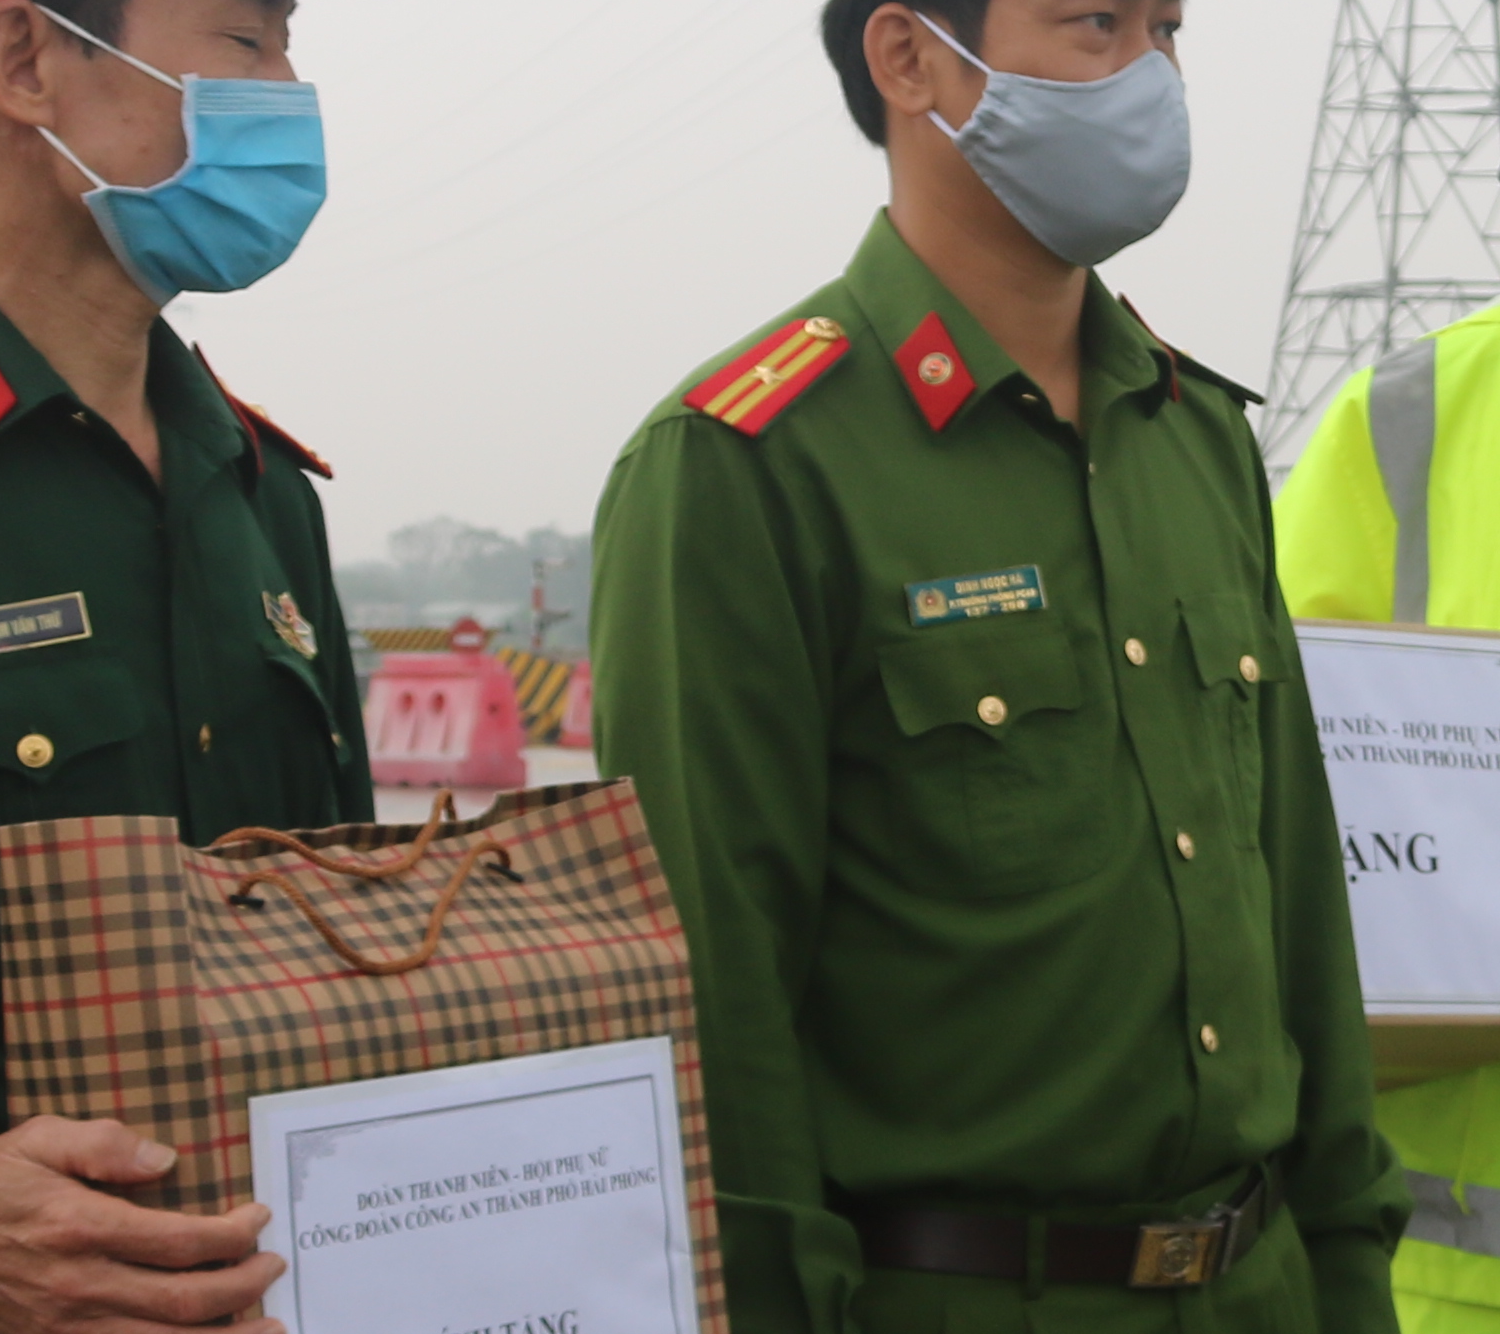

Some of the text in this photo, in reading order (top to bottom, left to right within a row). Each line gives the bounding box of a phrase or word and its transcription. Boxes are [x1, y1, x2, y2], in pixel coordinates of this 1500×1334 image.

[1332, 745, 1356, 762] AN
[1341, 713, 1388, 735] NIÊN
[1402, 720, 1439, 743] HỘI
[1443, 723, 1477, 746] PHỤ
[1342, 825, 1439, 883] ẶNG
[298, 1223, 351, 1251] CÔNG
[354, 1210, 402, 1241] ĐOÀN
[404, 1203, 453, 1231] CÔNG
[458, 1199, 482, 1220] AN
[485, 1186, 542, 1216] THÀNH
[610, 1166, 657, 1193] PHÒNG
[356, 1182, 406, 1212] ĐOÀN
[409, 1174, 468, 1202] THANH
[471, 1163, 512, 1190] NIÊN
[522, 1157, 552, 1183] HỘI
[555, 1153, 584, 1175] PHỤ
